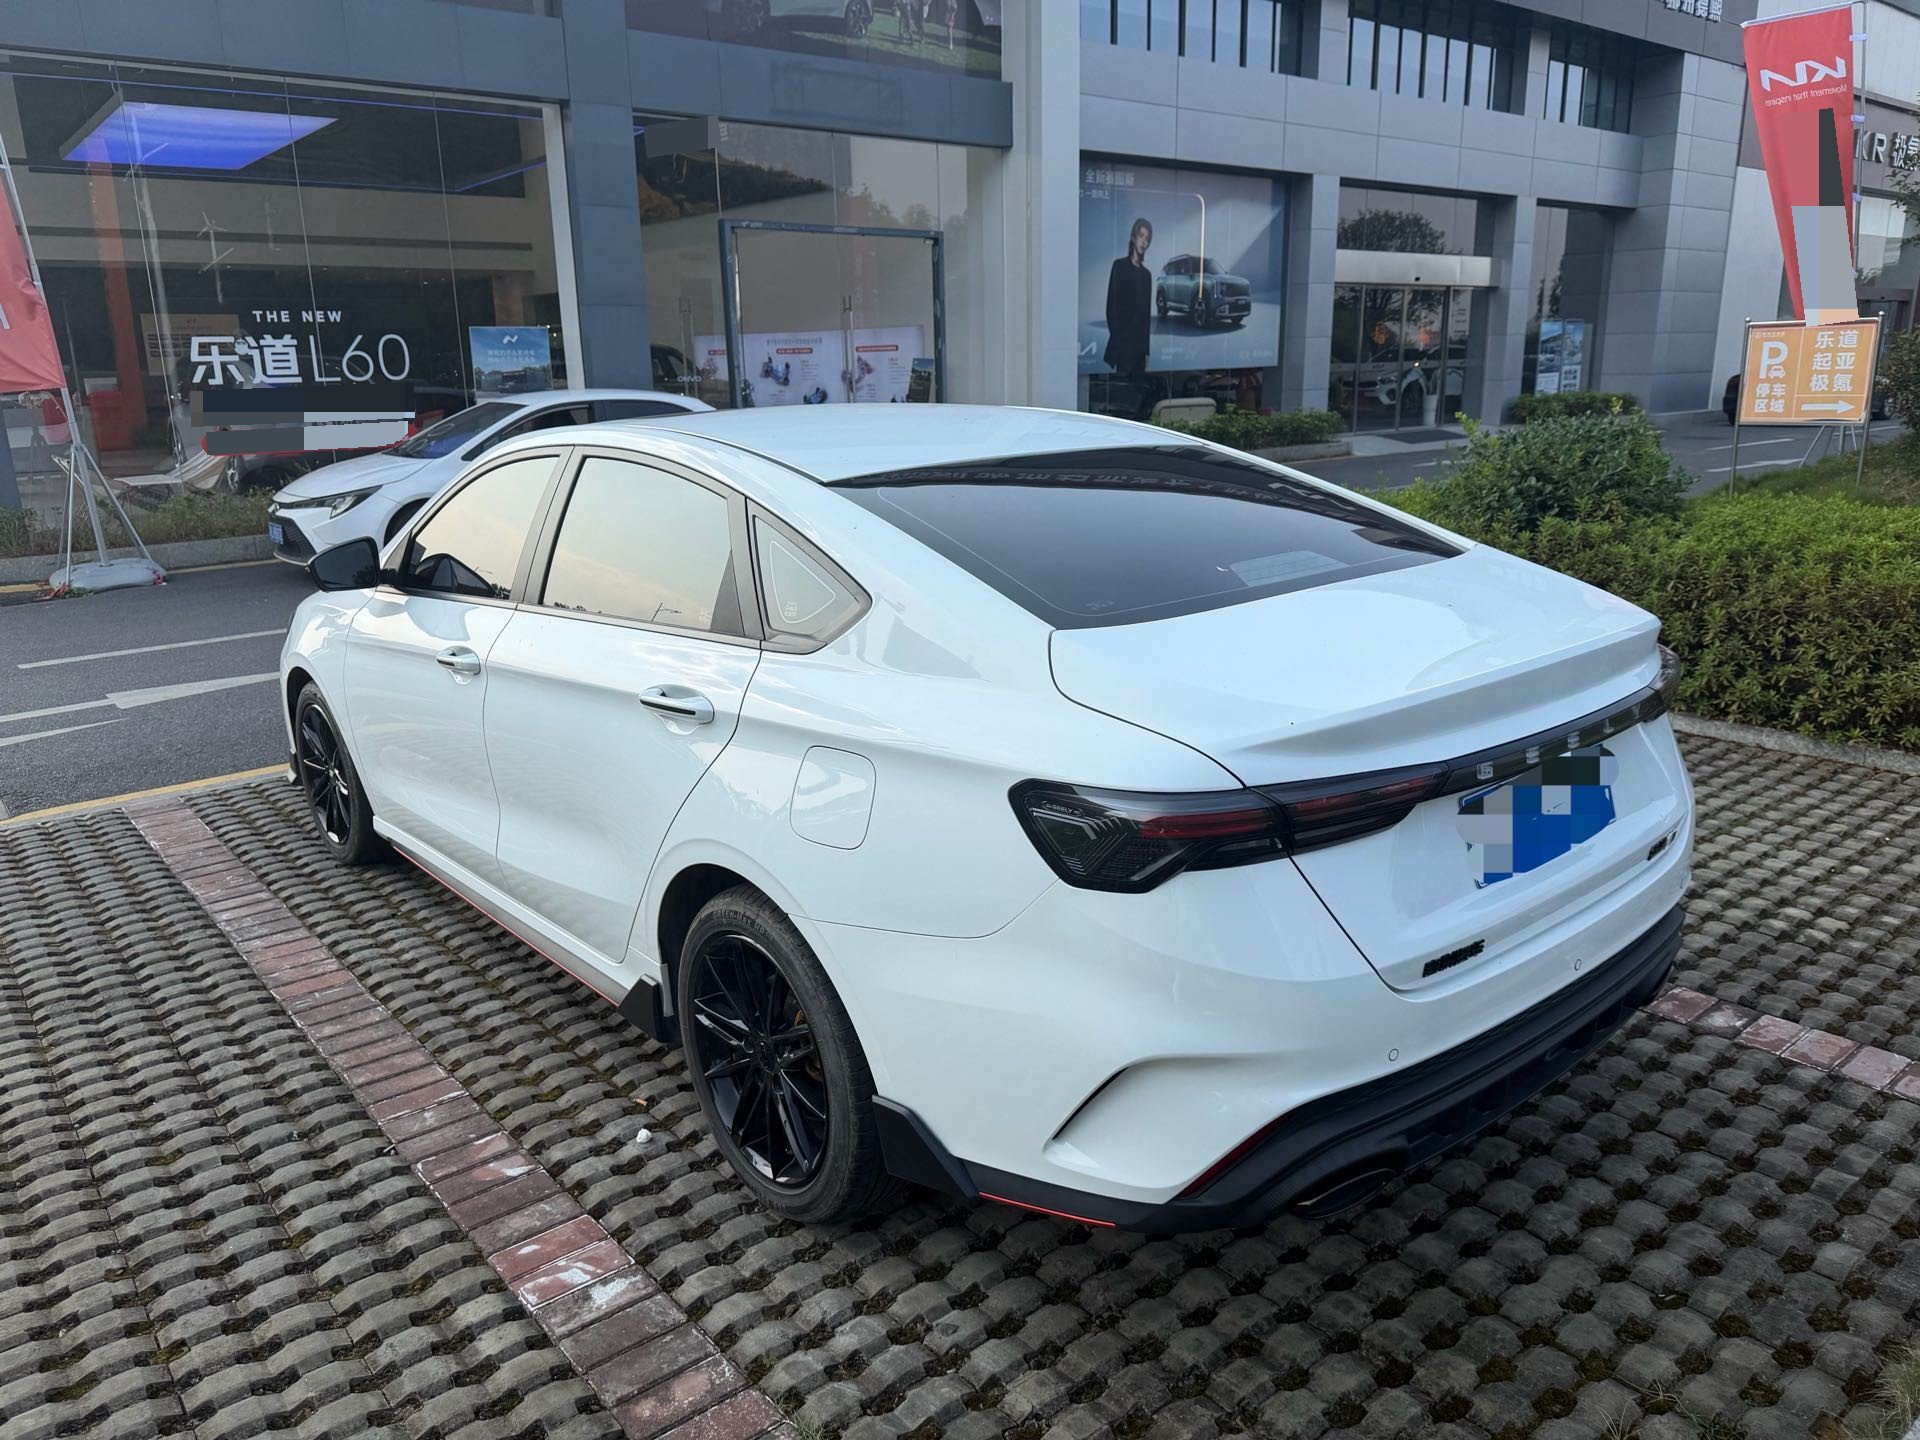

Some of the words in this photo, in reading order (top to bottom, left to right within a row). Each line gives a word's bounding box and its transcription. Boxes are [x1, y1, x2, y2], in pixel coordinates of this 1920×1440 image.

[252, 310, 290, 323] THE
[302, 310, 342, 323] NEW
[1815, 330, 1858, 348] 乐道
[309, 334, 410, 382] L60
[1759, 341, 1788, 378] P
[1812, 352, 1856, 370] 起亚
[1756, 384, 1786, 397] 停车
[1810, 374, 1853, 391] 极氪
[1754, 399, 1784, 412] 区域
